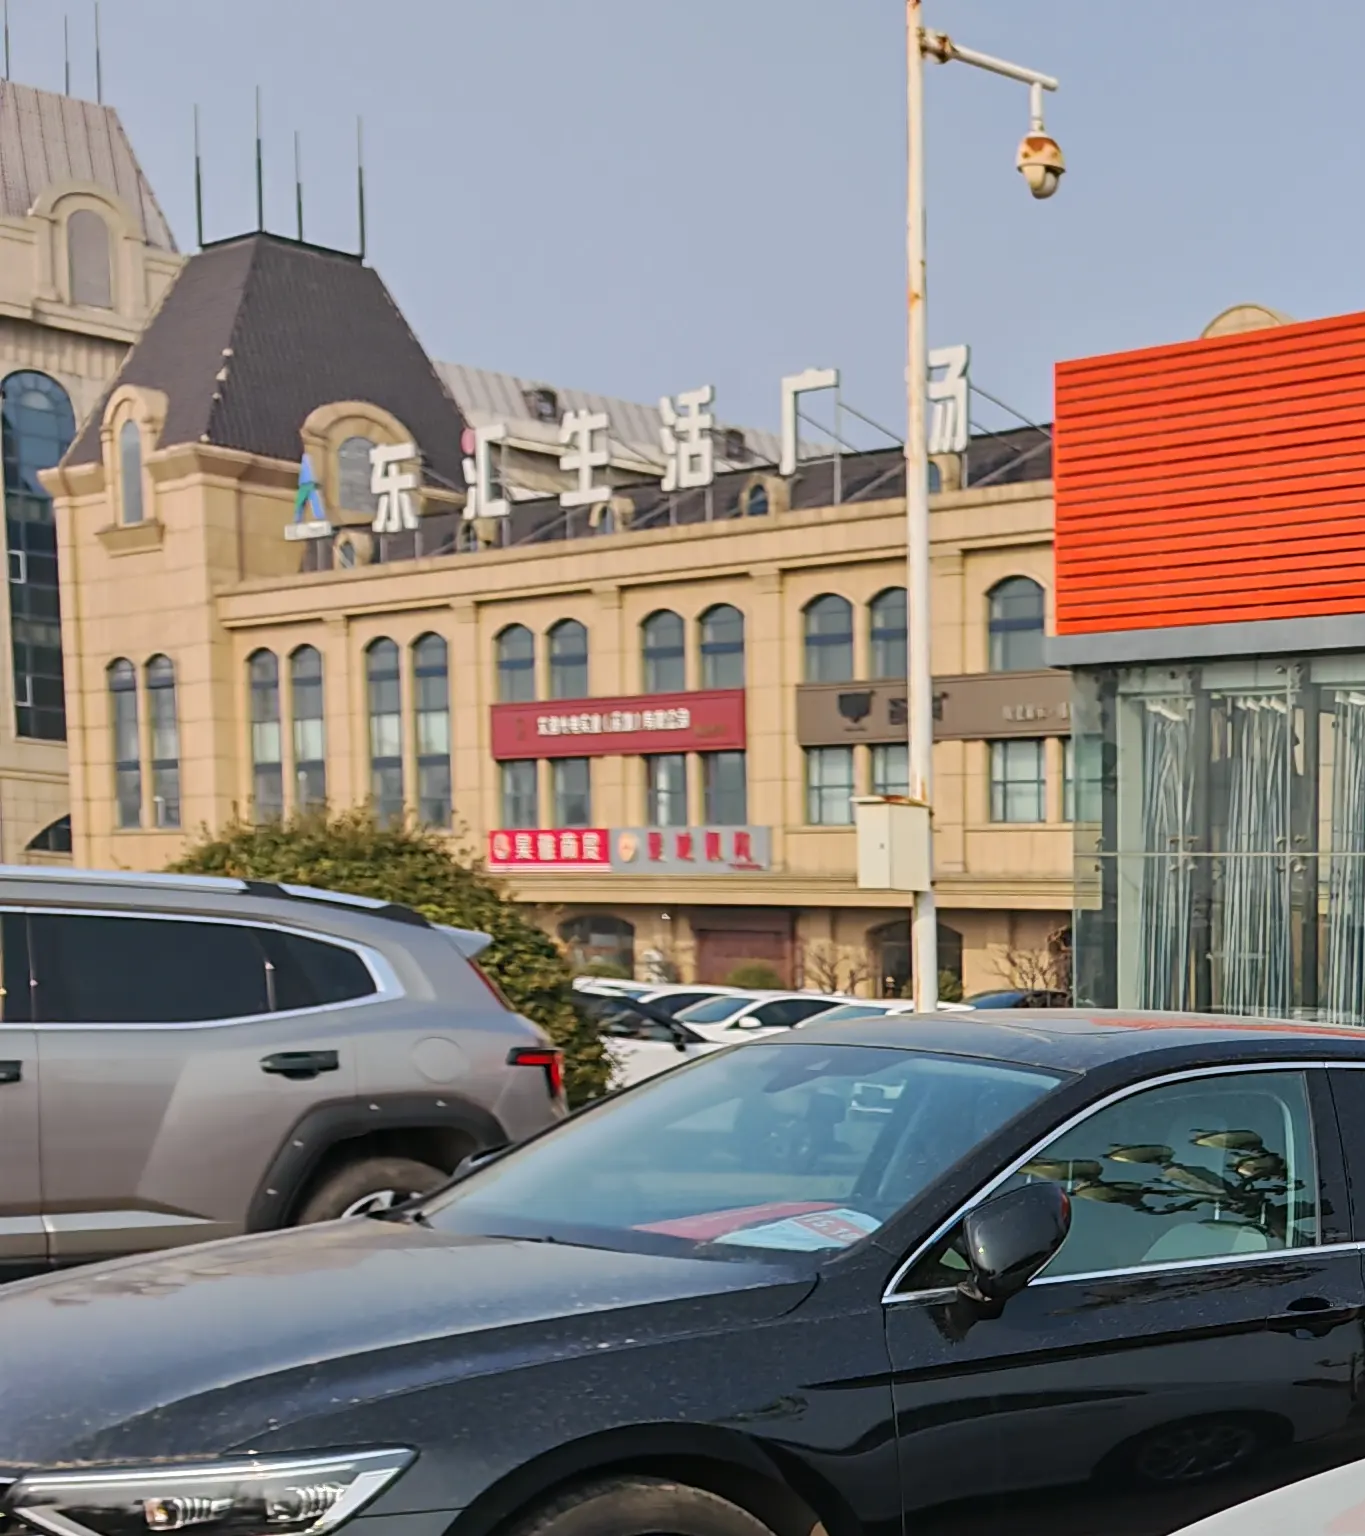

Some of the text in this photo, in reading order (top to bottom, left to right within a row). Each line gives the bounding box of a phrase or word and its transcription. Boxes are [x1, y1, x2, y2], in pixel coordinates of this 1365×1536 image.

[370, 344, 970, 533] 东汇生活广场
